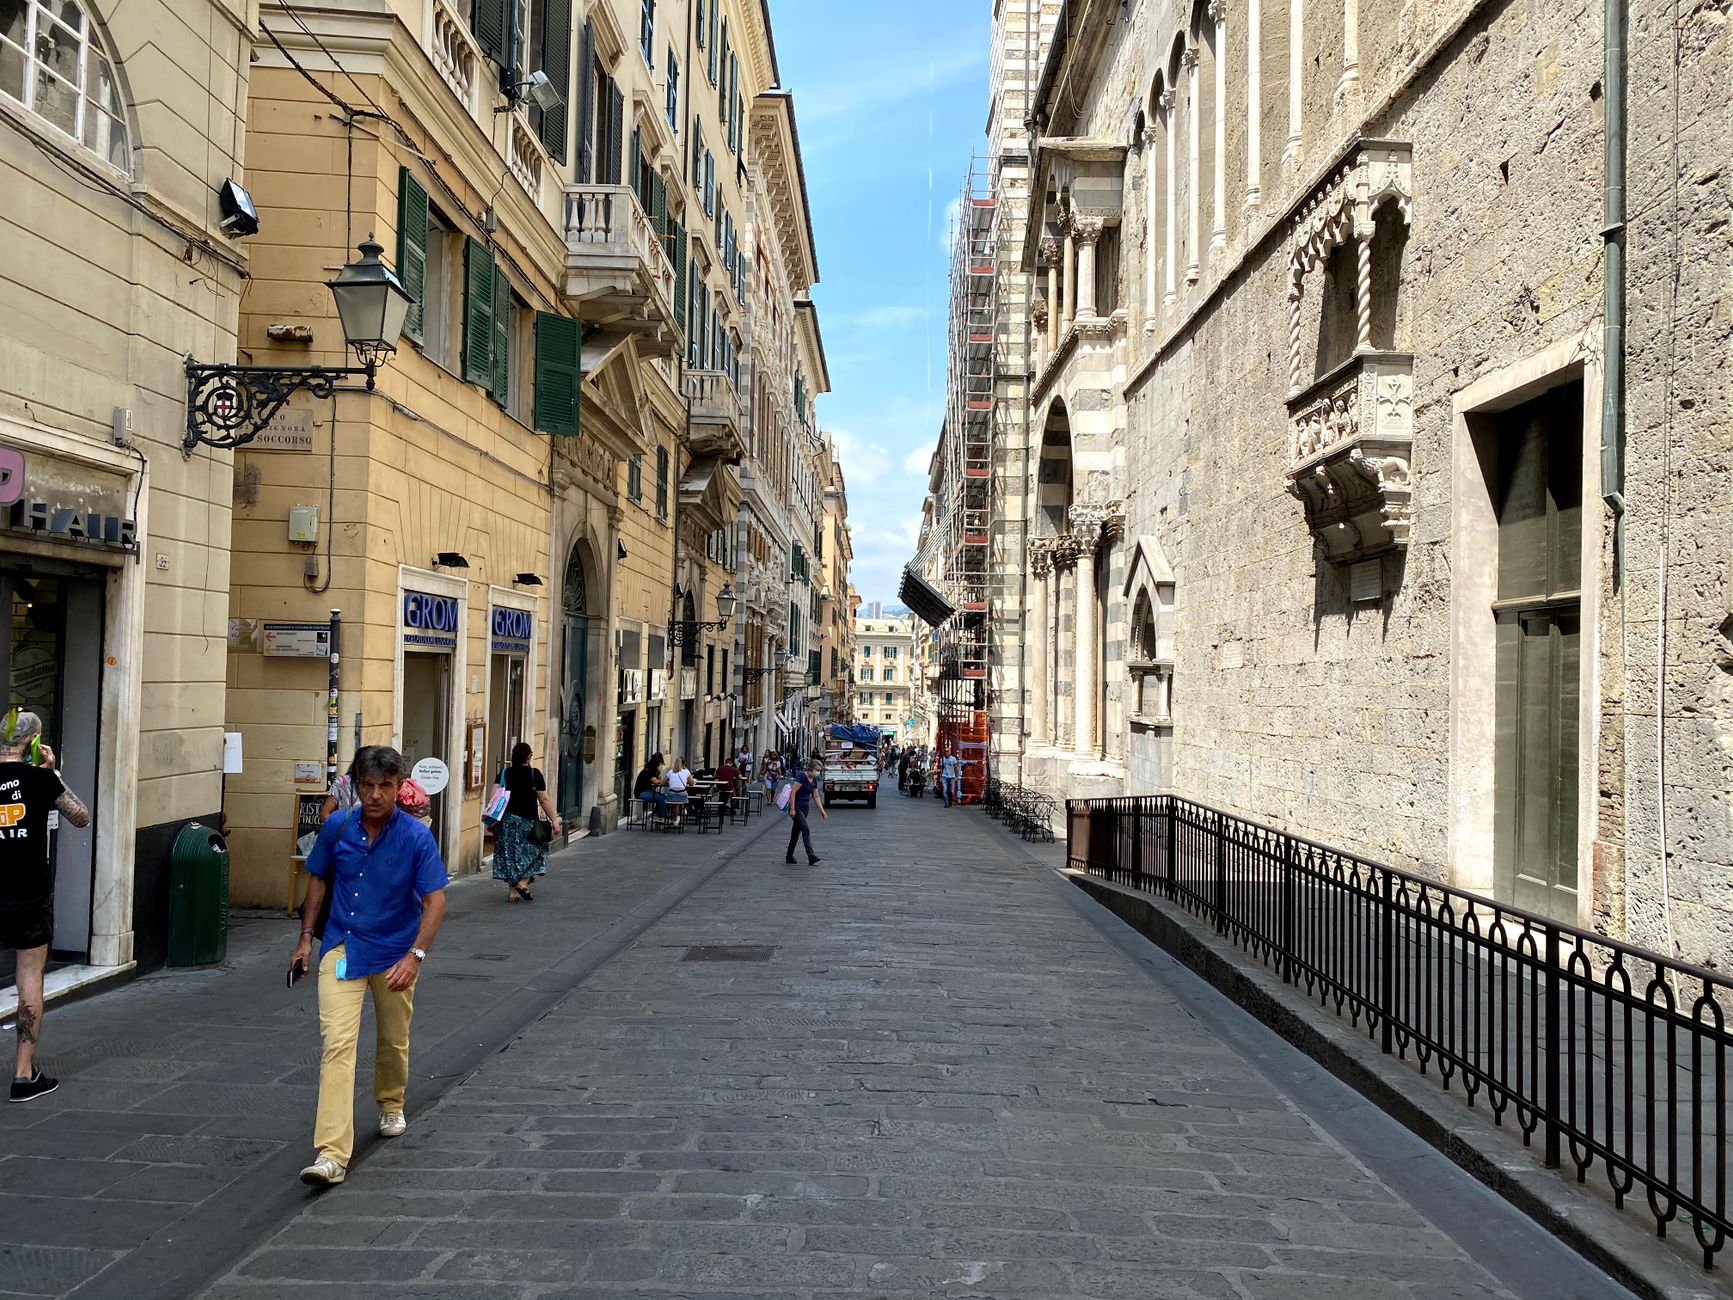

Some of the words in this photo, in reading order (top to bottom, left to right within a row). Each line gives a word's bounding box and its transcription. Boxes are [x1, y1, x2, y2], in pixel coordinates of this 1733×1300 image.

[268, 425, 306, 433] IGNORA
[256, 434, 312, 445] SOCCORSO
[10, 498, 138, 546] HAIR
[404, 593, 459, 632] GROM
[492, 606, 532, 639] GROM
[0, 780, 20, 791] ono
[12, 790, 22, 800] di
[0, 828, 28, 839] AIR
